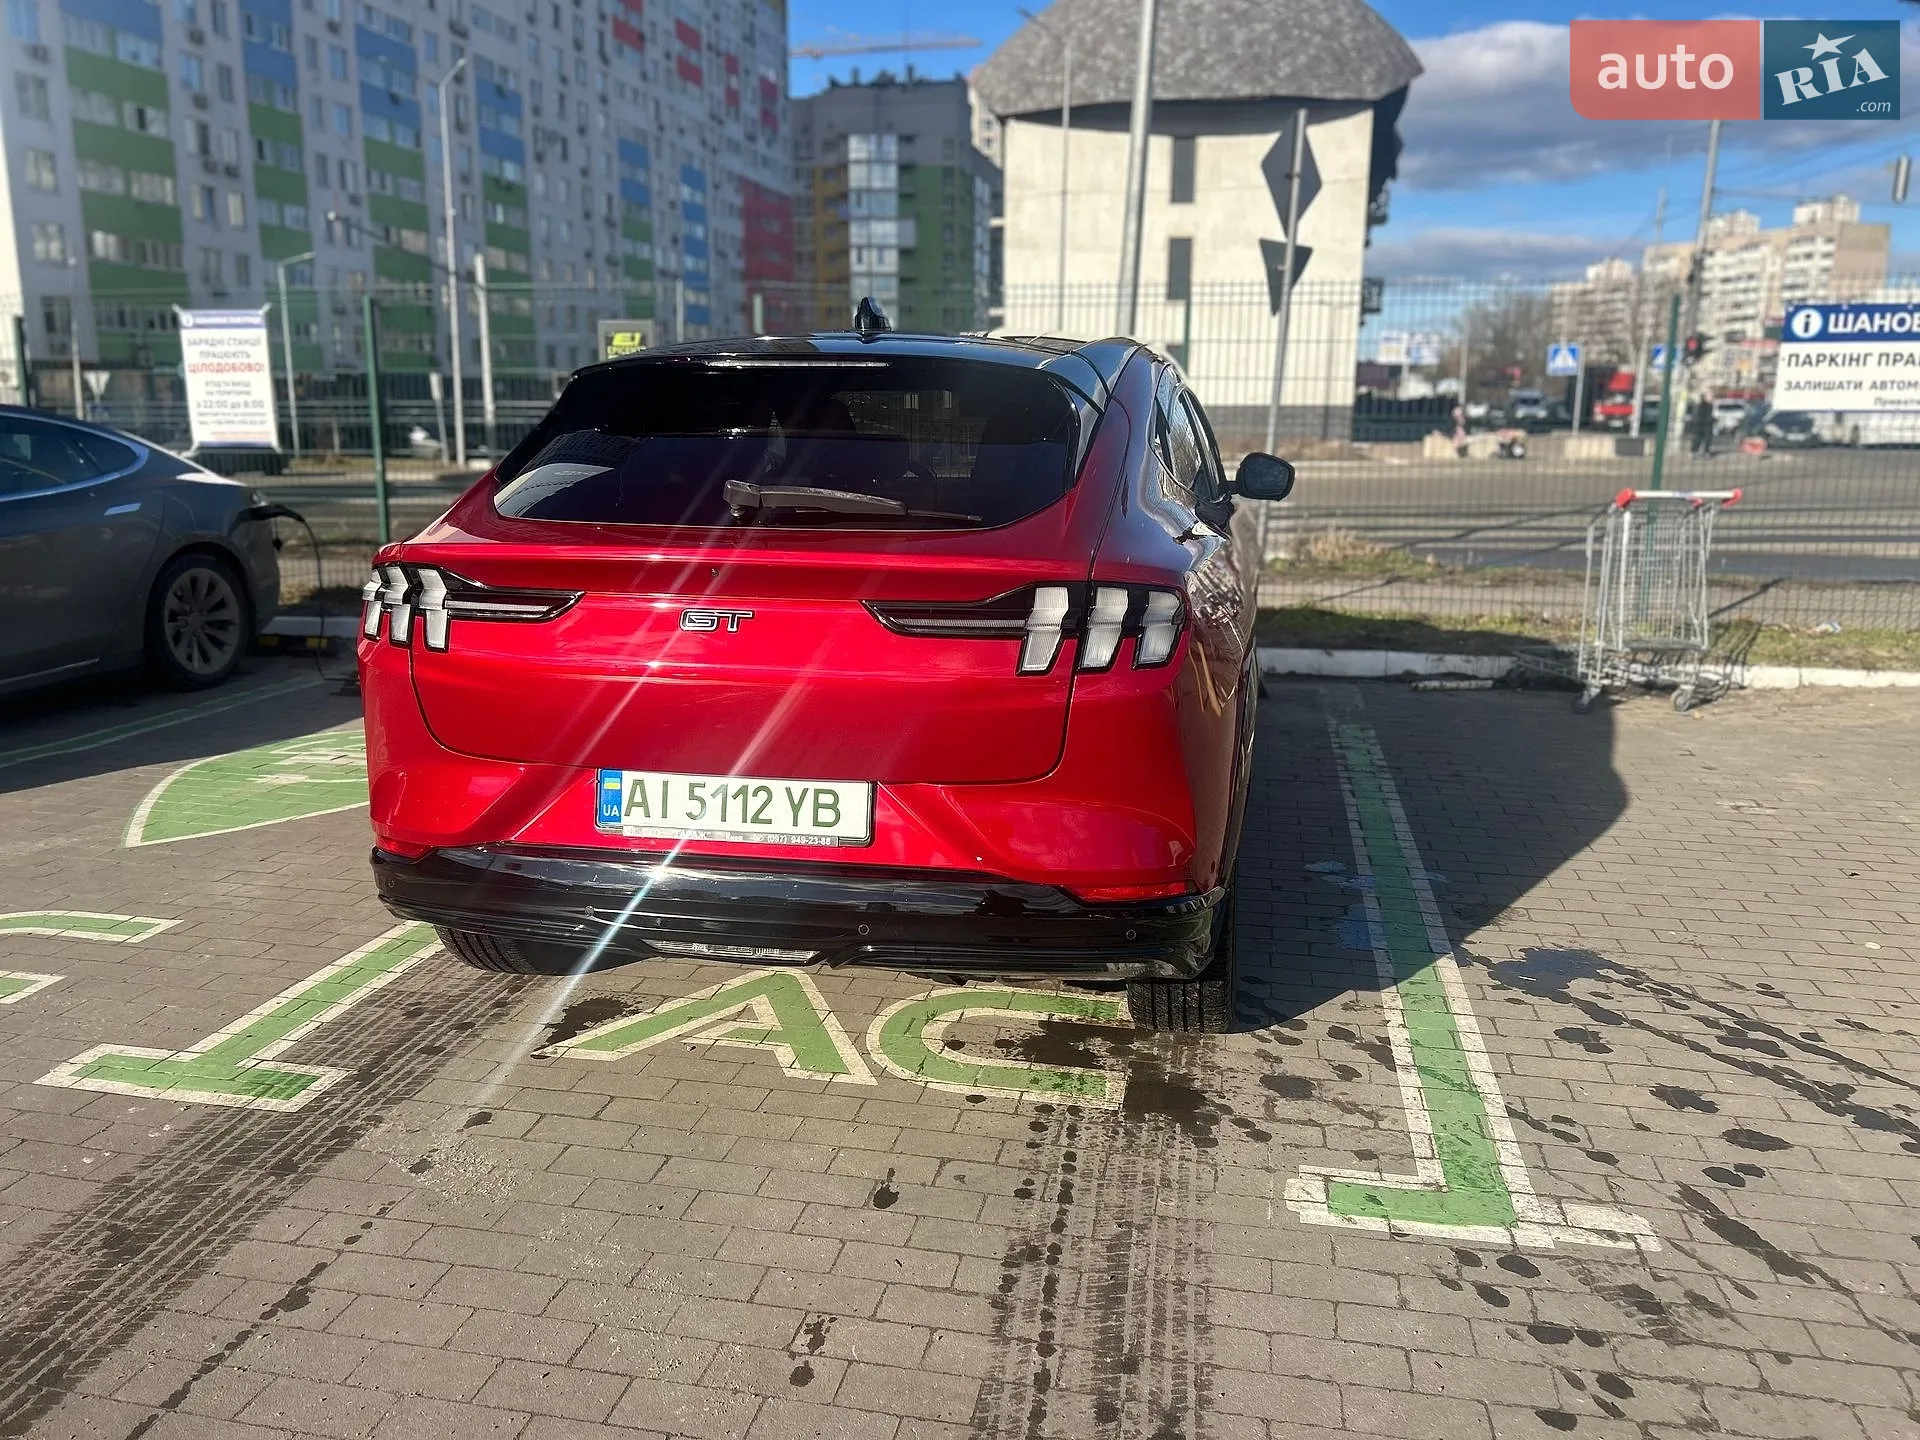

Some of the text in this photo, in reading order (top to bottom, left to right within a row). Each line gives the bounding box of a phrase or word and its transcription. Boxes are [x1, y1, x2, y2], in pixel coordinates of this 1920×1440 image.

[199, 350, 251, 360] ПРАЦЮЮТЬ
[1787, 352, 1920, 367] ПАРКІНГ ПРА
[188, 362, 265, 374] ЦІЛОДОБОВО!
[1784, 380, 1863, 391] ЗАЛИШАТИ
[680, 608, 754, 632] GT
[603, 803, 620, 817] UA
[624, 778, 841, 828] AI 5112 YB
[533, 967, 1132, 1110] AC
